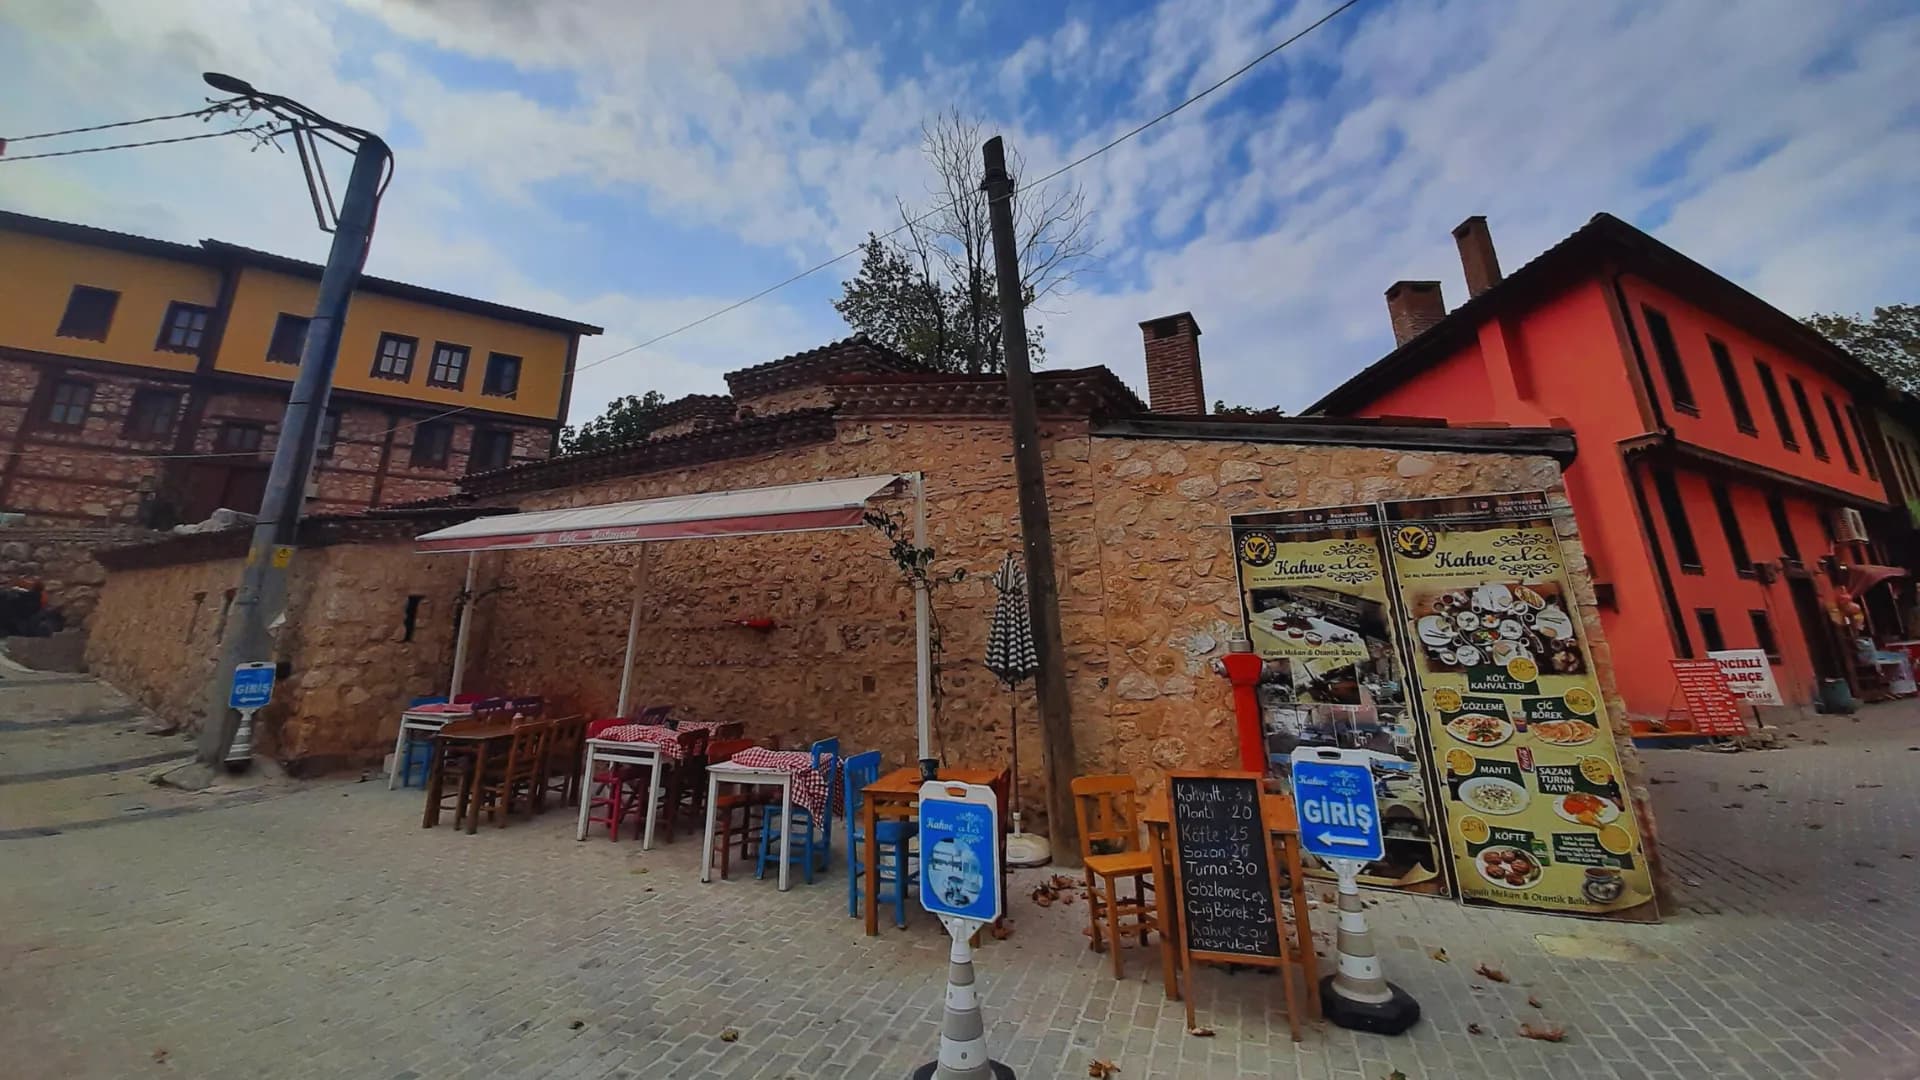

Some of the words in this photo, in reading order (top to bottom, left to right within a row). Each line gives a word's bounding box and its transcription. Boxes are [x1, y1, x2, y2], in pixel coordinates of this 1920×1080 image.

[1435, 551, 1497, 569] Kahve
[1274, 559, 1326, 576] Kahve
[1719, 657, 1762, 669] NCİRLİ
[1486, 674, 1505, 683] KÖY
[1471, 682, 1525, 690] KAHVALTISI
[1462, 702, 1504, 711] GÖZLEME
[1531, 710, 1563, 720] BÖREK
[1480, 766, 1511, 775] MANTI
[1539, 767, 1572, 776] SAZAN
[1542, 775, 1575, 784] TURNA
[1544, 783, 1574, 793] YAYIN
[1304, 795, 1373, 834] GİRİŞ
[1495, 831, 1527, 842] KÖFTE
